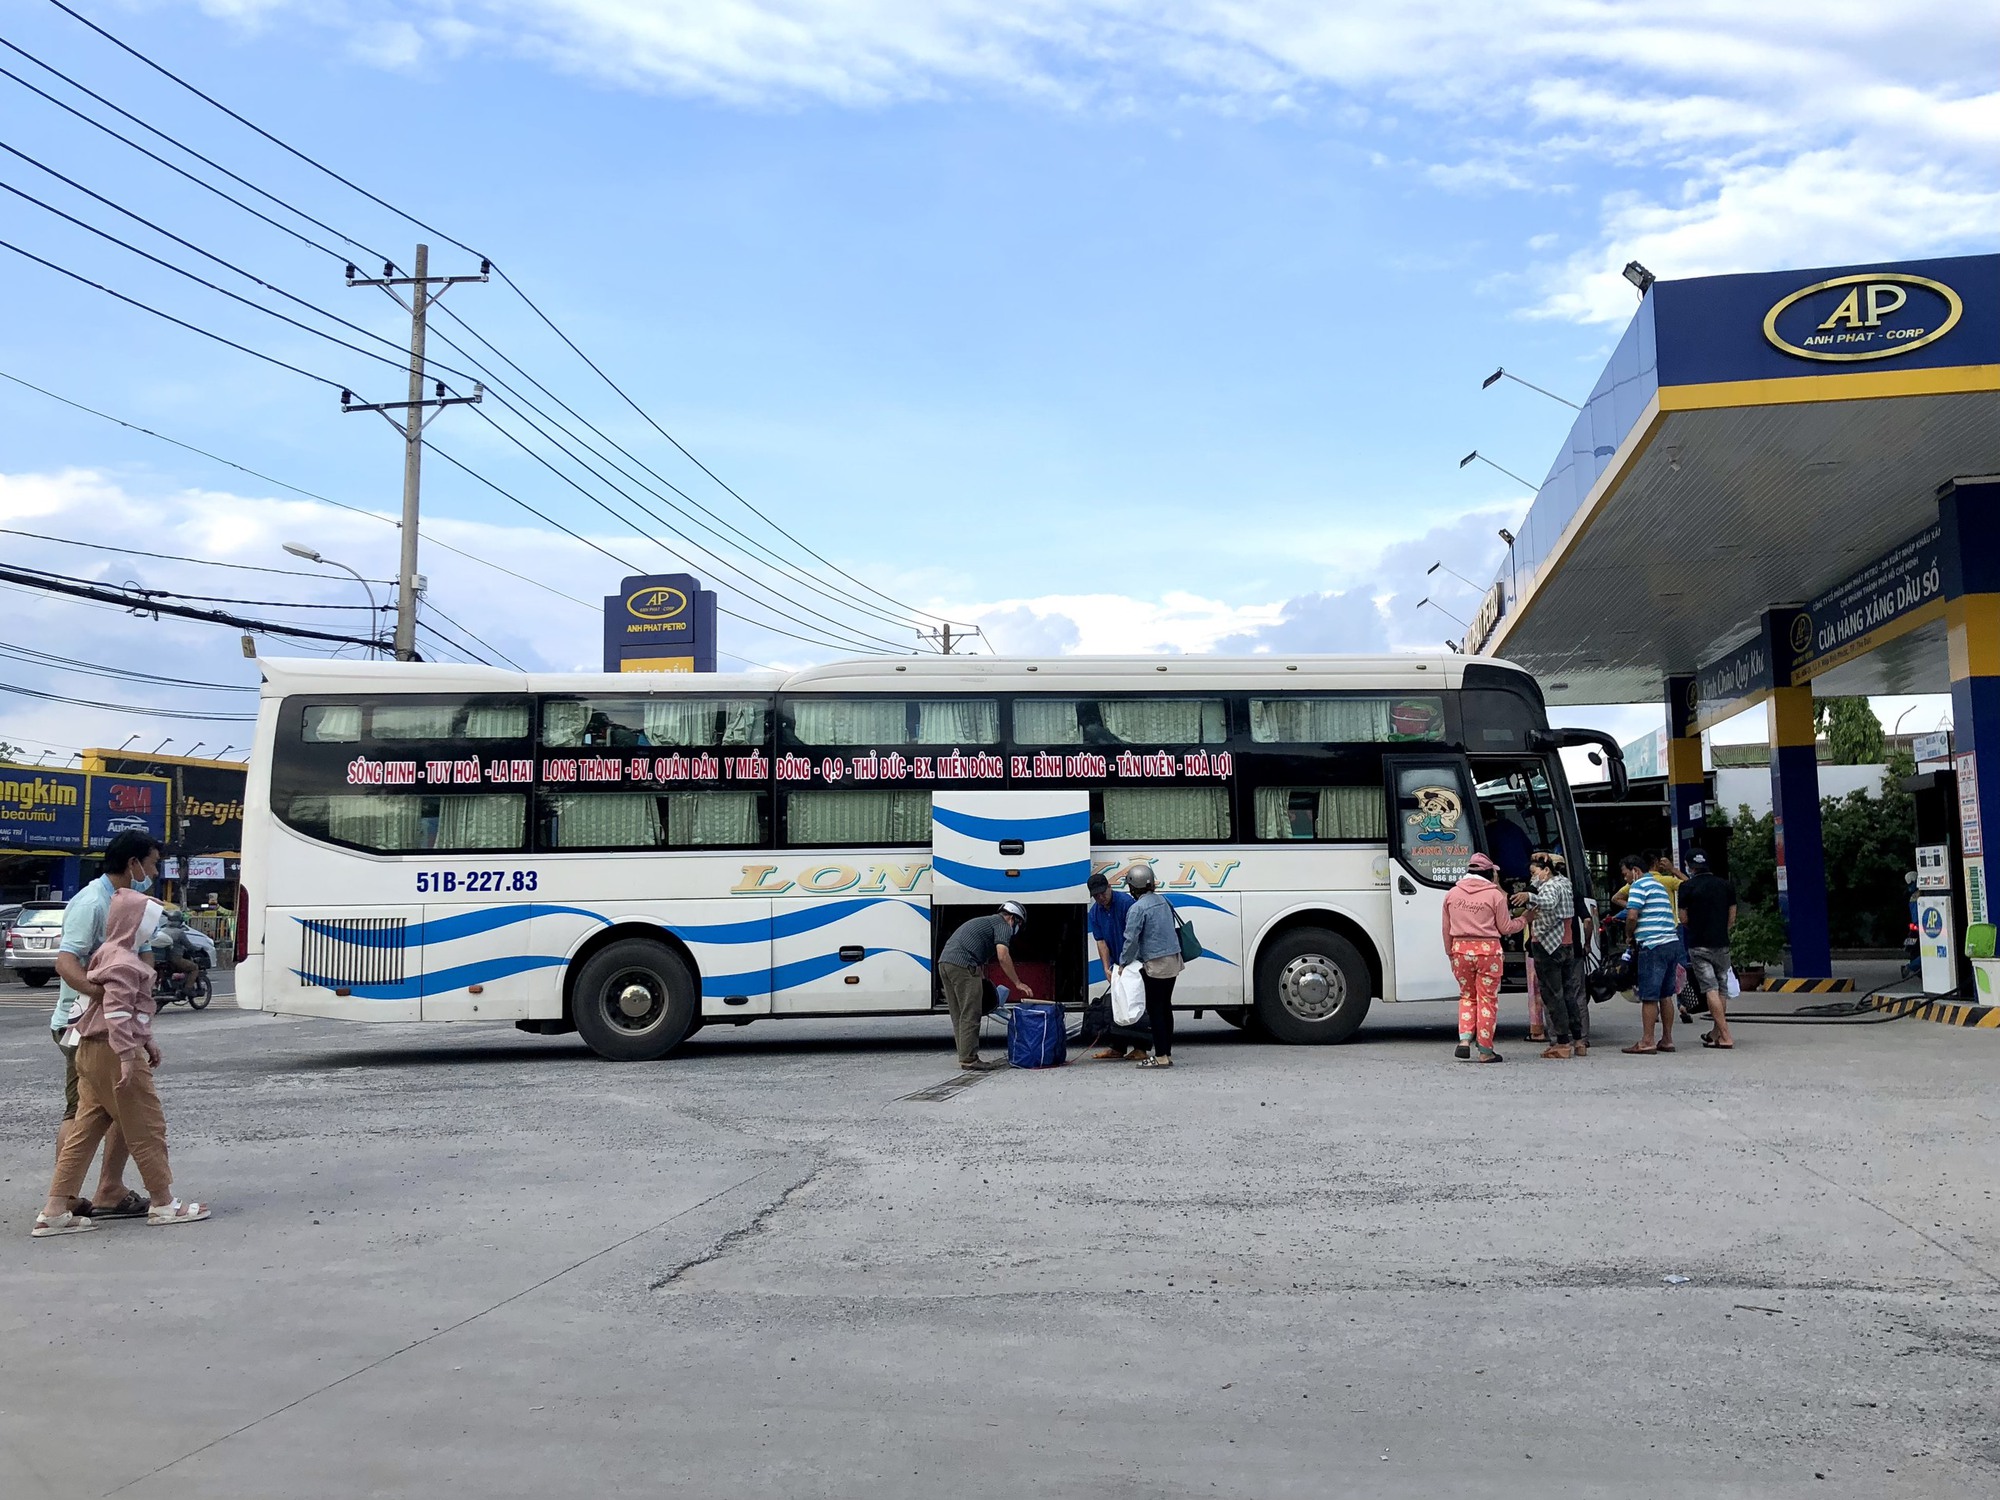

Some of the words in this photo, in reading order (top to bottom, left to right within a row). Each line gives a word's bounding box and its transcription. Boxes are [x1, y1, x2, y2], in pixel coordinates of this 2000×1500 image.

[1816, 284, 1907, 329] AP
[1803, 335, 1834, 346] ANH
[1836, 332, 1875, 344] PHAT
[1886, 328, 1925, 340] CORP
[645, 591, 670, 606] AP
[1818, 620, 1836, 651] CỬA
[1837, 609, 1864, 642] HÀNG
[1865, 593, 1895, 628] XĂNG
[1896, 574, 1921, 611] DẦU
[1922, 556, 1940, 597] SỐ
[627, 624, 643, 633] ANH
[643, 623, 662, 632] PHAT
[662, 622, 687, 631] PETRO
[347, 756, 383, 784] SÔNG
[384, 761, 416, 784] HINH
[426, 761, 452, 784] TUY
[454, 755, 481, 783] HOÀ
[510, 760, 534, 782] HAI
[543, 759, 577, 781] LONG
[578, 755, 621, 781] THÀNH
[655, 753, 689, 783] QUÂN
[692, 752, 718, 780] DÂN
[725, 757, 735, 779] Y
[736, 749, 768, 780] MIỀN
[776, 752, 811, 780] ĐÔNG
[822, 757, 843, 783] Q.9
[852, 750, 878, 779] THỦ
[880, 752, 906, 779] ĐỨC
[914, 757, 935, 778] BX.
[937, 748, 968, 778] MIỀN
[969, 751, 1003, 778] ĐÔNG
[1011, 756, 1032, 778] BX.
[1033, 751, 1063, 777] BÌNH
[1066, 752, 1106, 777] DƯƠNG
[1116, 750, 1142, 777] TÂN
[1143, 750, 1175, 778] UYÊN
[1184, 749, 1210, 777] HOÀ
[1211, 750, 1233, 780] LỢI
[108, 784, 152, 815] 3M
[416, 870, 538, 893] 51B-227.83
[730, 863, 933, 894] LON
